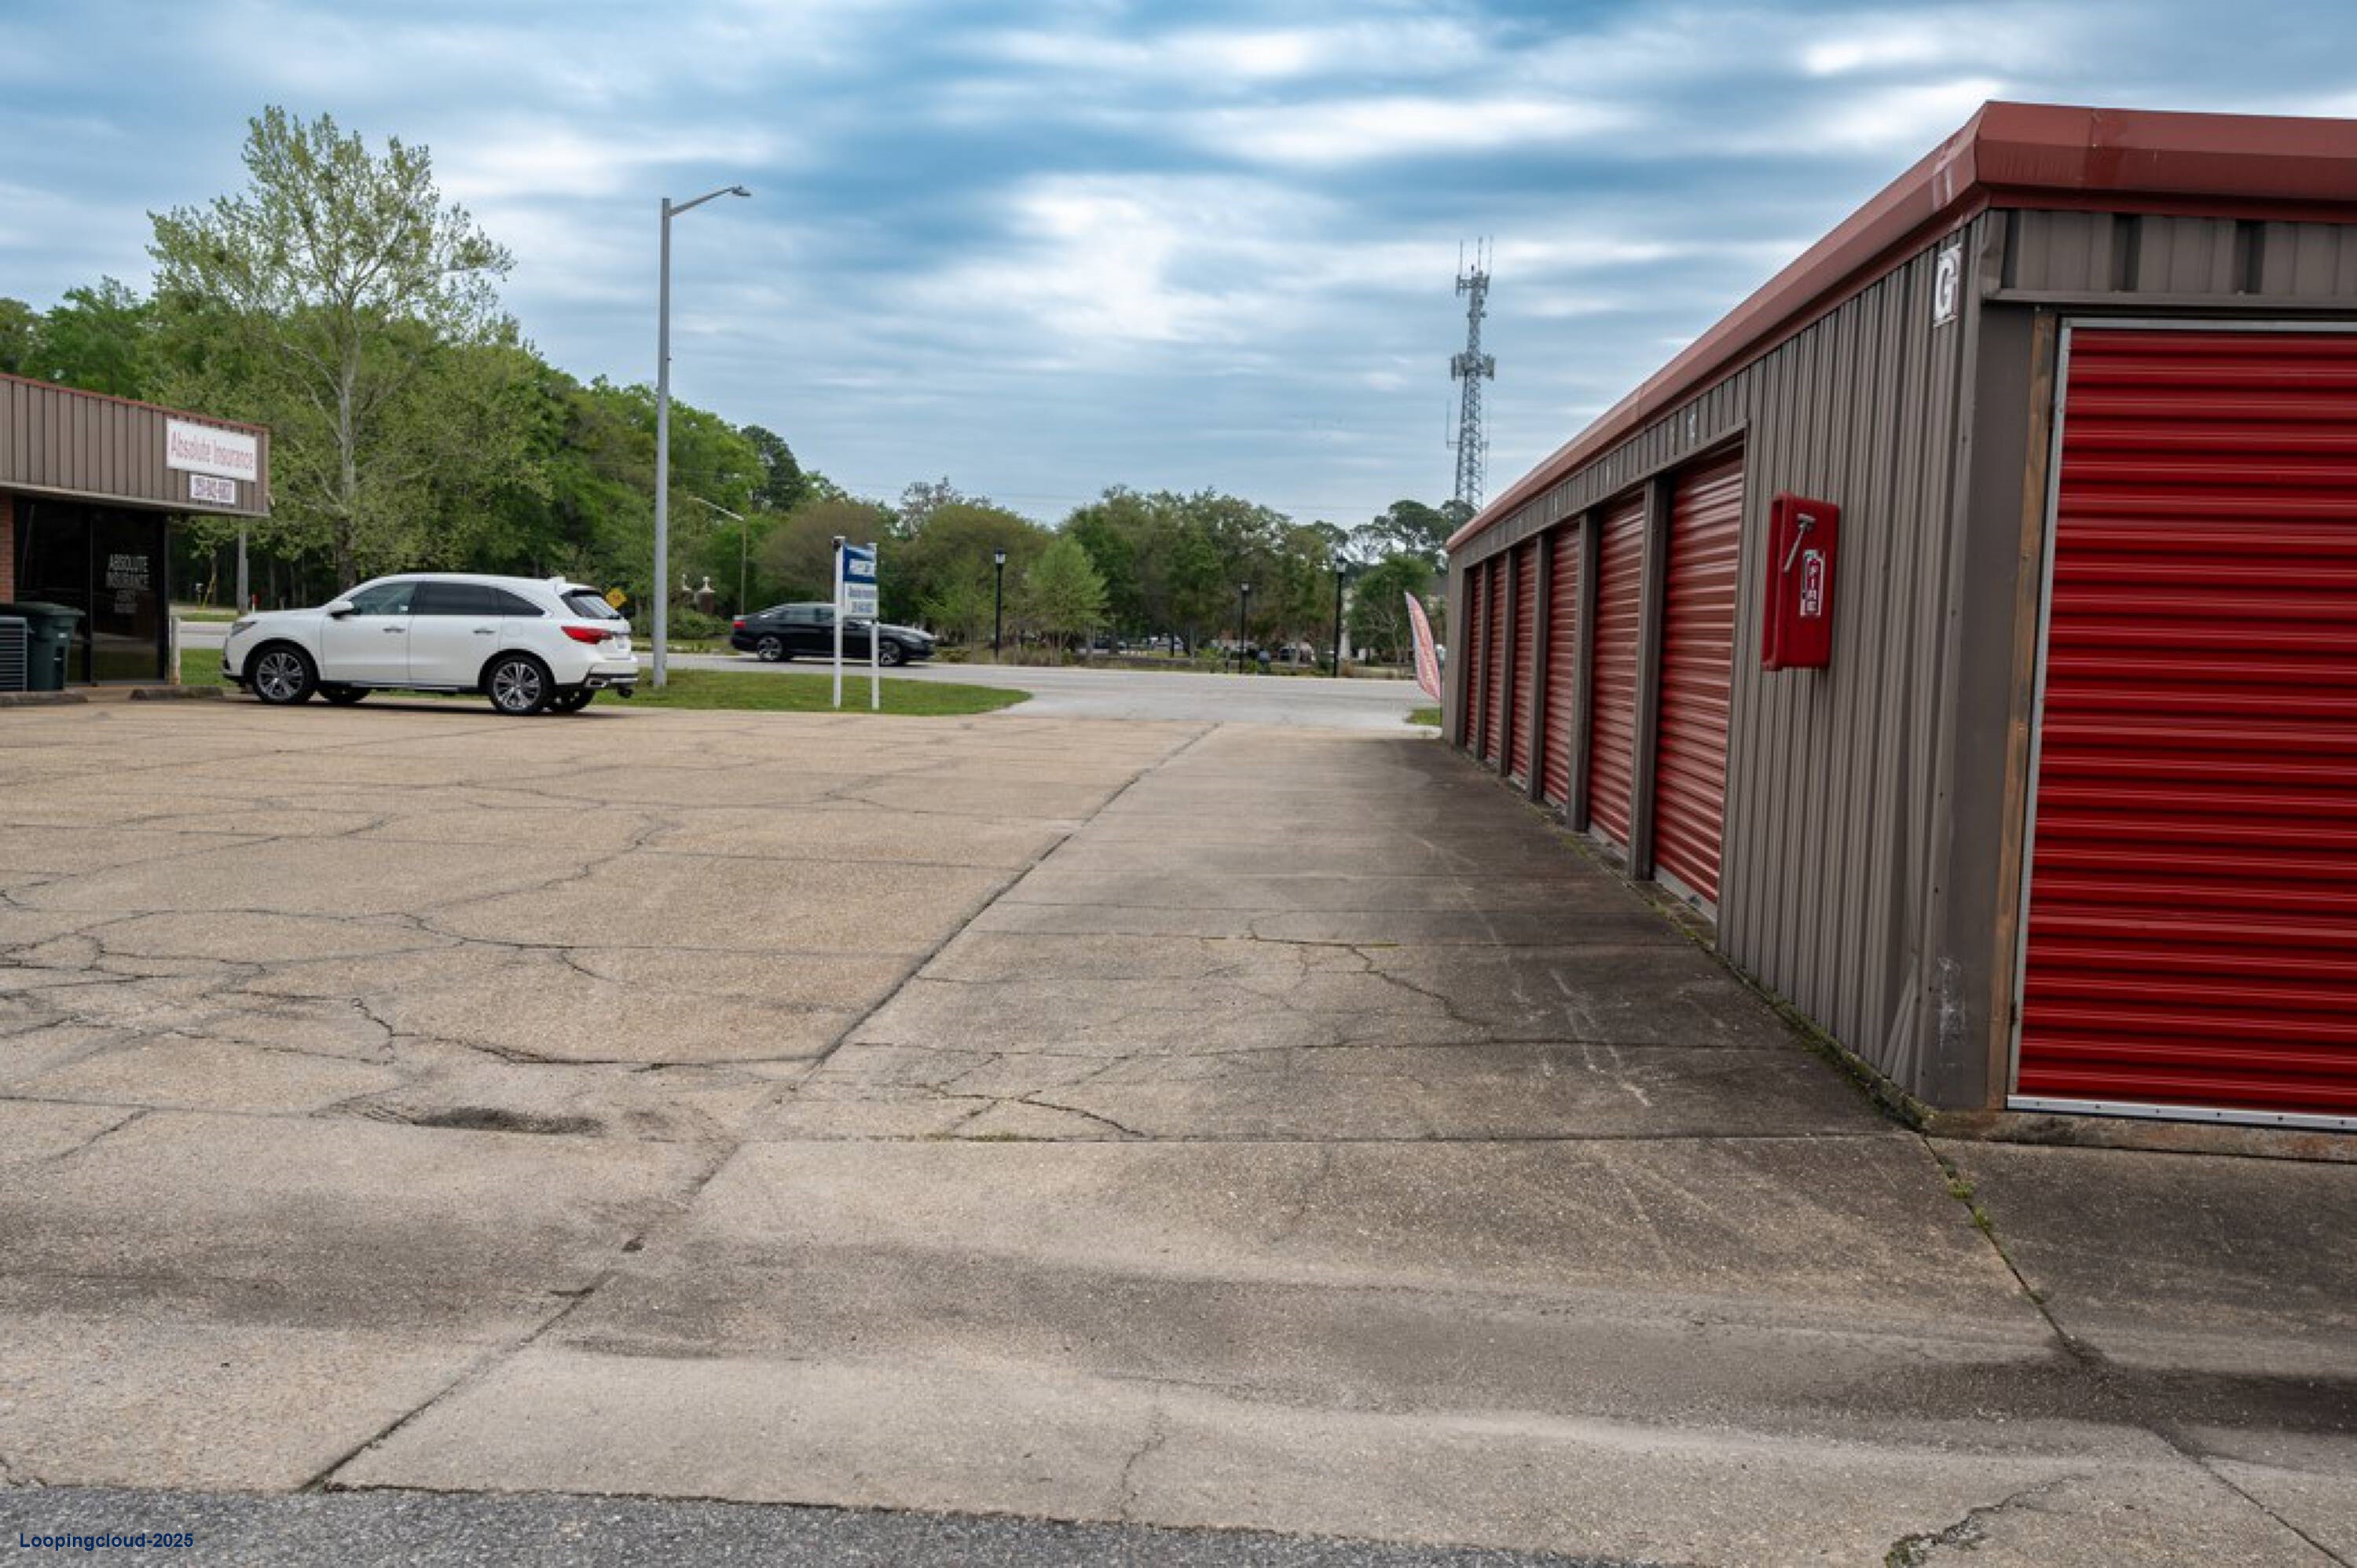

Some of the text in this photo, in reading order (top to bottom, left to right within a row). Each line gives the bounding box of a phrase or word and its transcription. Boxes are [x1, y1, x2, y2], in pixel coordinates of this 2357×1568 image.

[1935, 252, 1957, 319] G
[170, 431, 253, 471] Absolute Insurance
[108, 553, 149, 573] ABSOLUTE
[1806, 565, 1817, 612] FIRE
